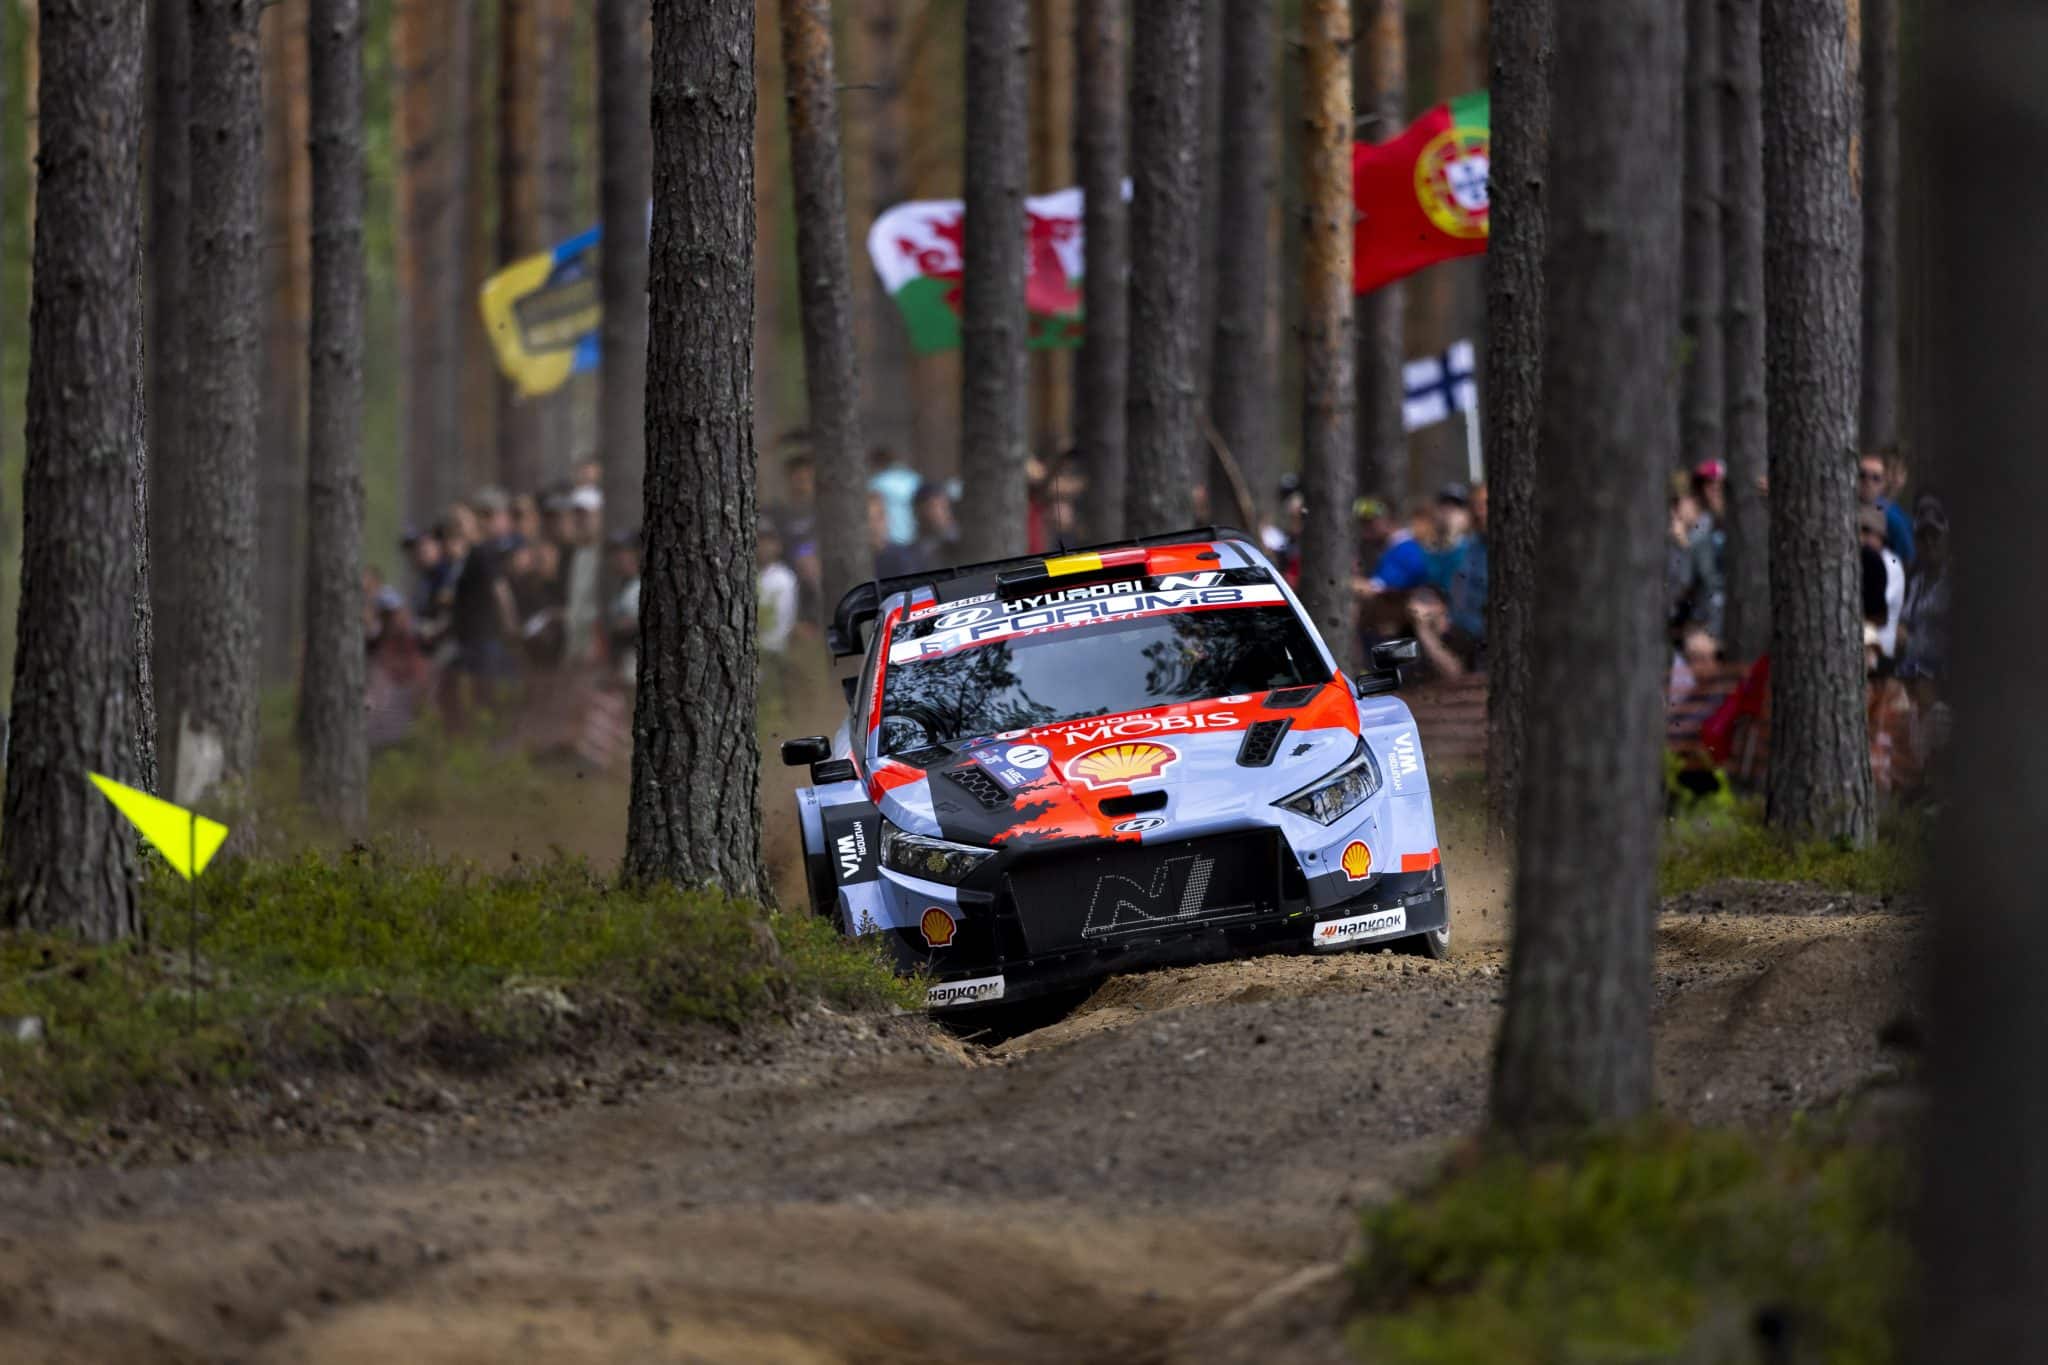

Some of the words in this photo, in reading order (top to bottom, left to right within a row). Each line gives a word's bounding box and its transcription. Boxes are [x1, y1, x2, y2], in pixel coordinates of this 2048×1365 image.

[1002, 580, 1143, 613] HYUNDAI
[969, 588, 1244, 641] FORUM8
[1031, 713, 1152, 742] HYUNDAI
[1065, 711, 1240, 746] MOBIS
[1012, 748, 1045, 764] 11
